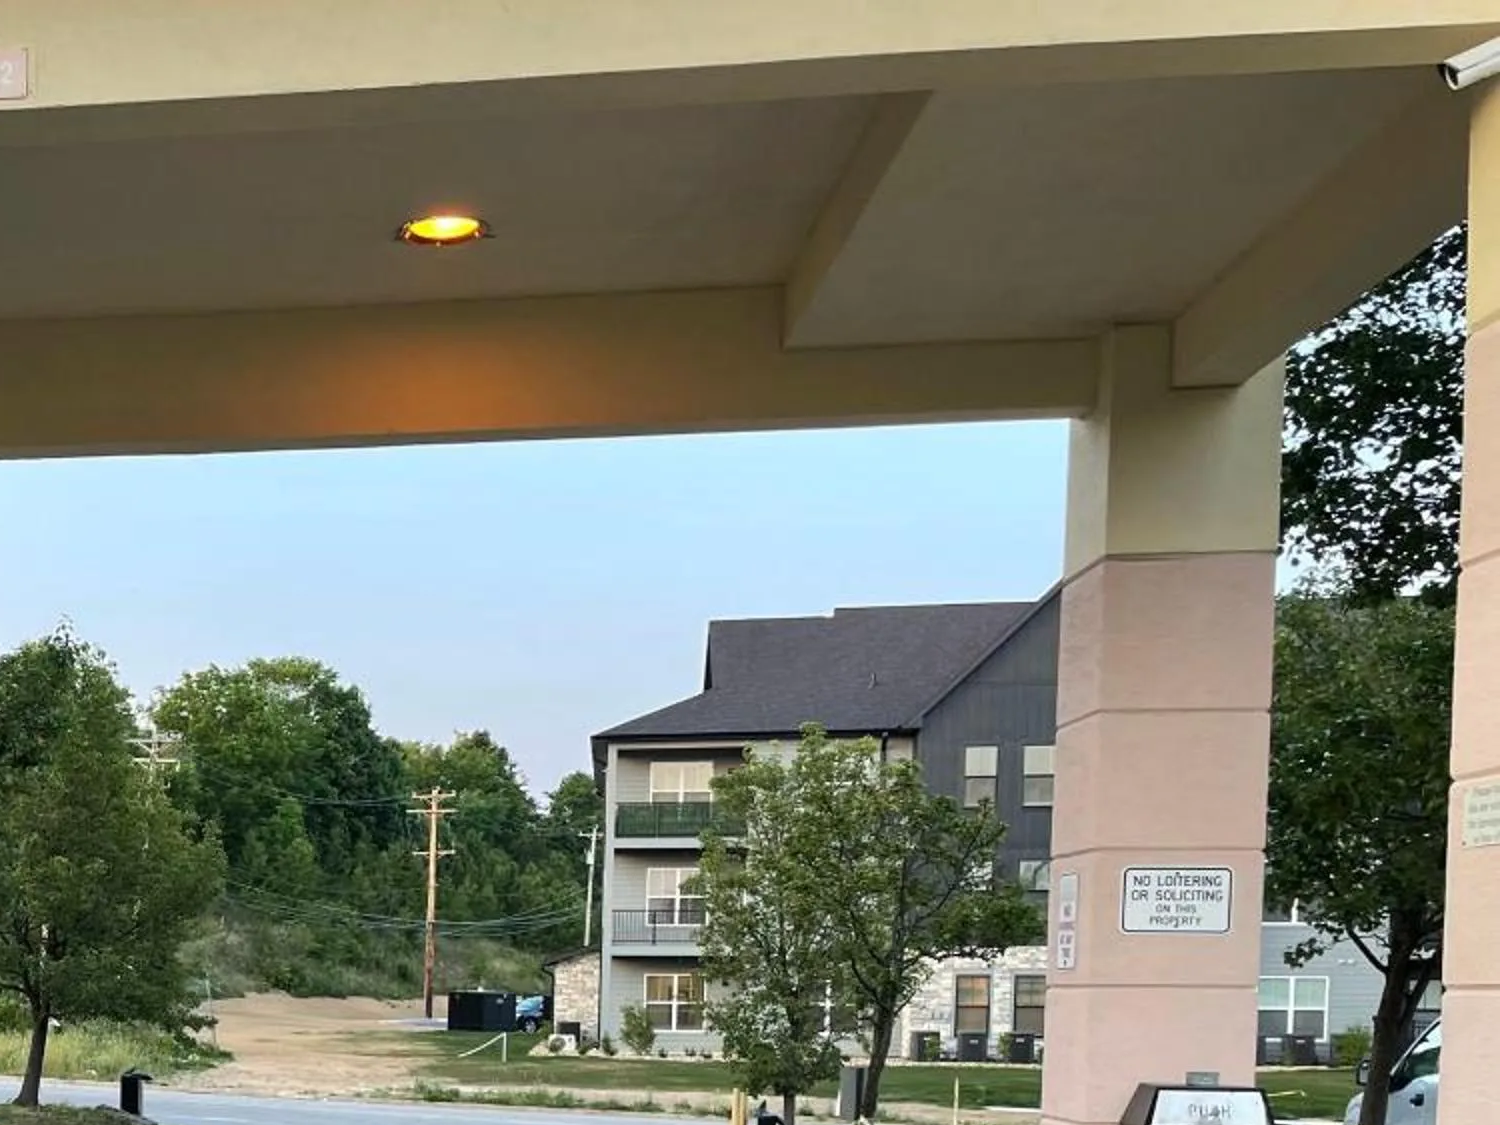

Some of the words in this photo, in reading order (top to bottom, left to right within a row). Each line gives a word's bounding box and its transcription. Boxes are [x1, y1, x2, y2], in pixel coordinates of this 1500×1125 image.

[1133, 875, 1151, 887] NO
[1157, 875, 1222, 887] LOITERING
[1131, 889, 1149, 901] OR
[1155, 889, 1224, 901] SOLICITING
[1155, 903, 1171, 913] ON
[1175, 903, 1197, 913] THIS
[1149, 915, 1202, 925] PROPERTY
